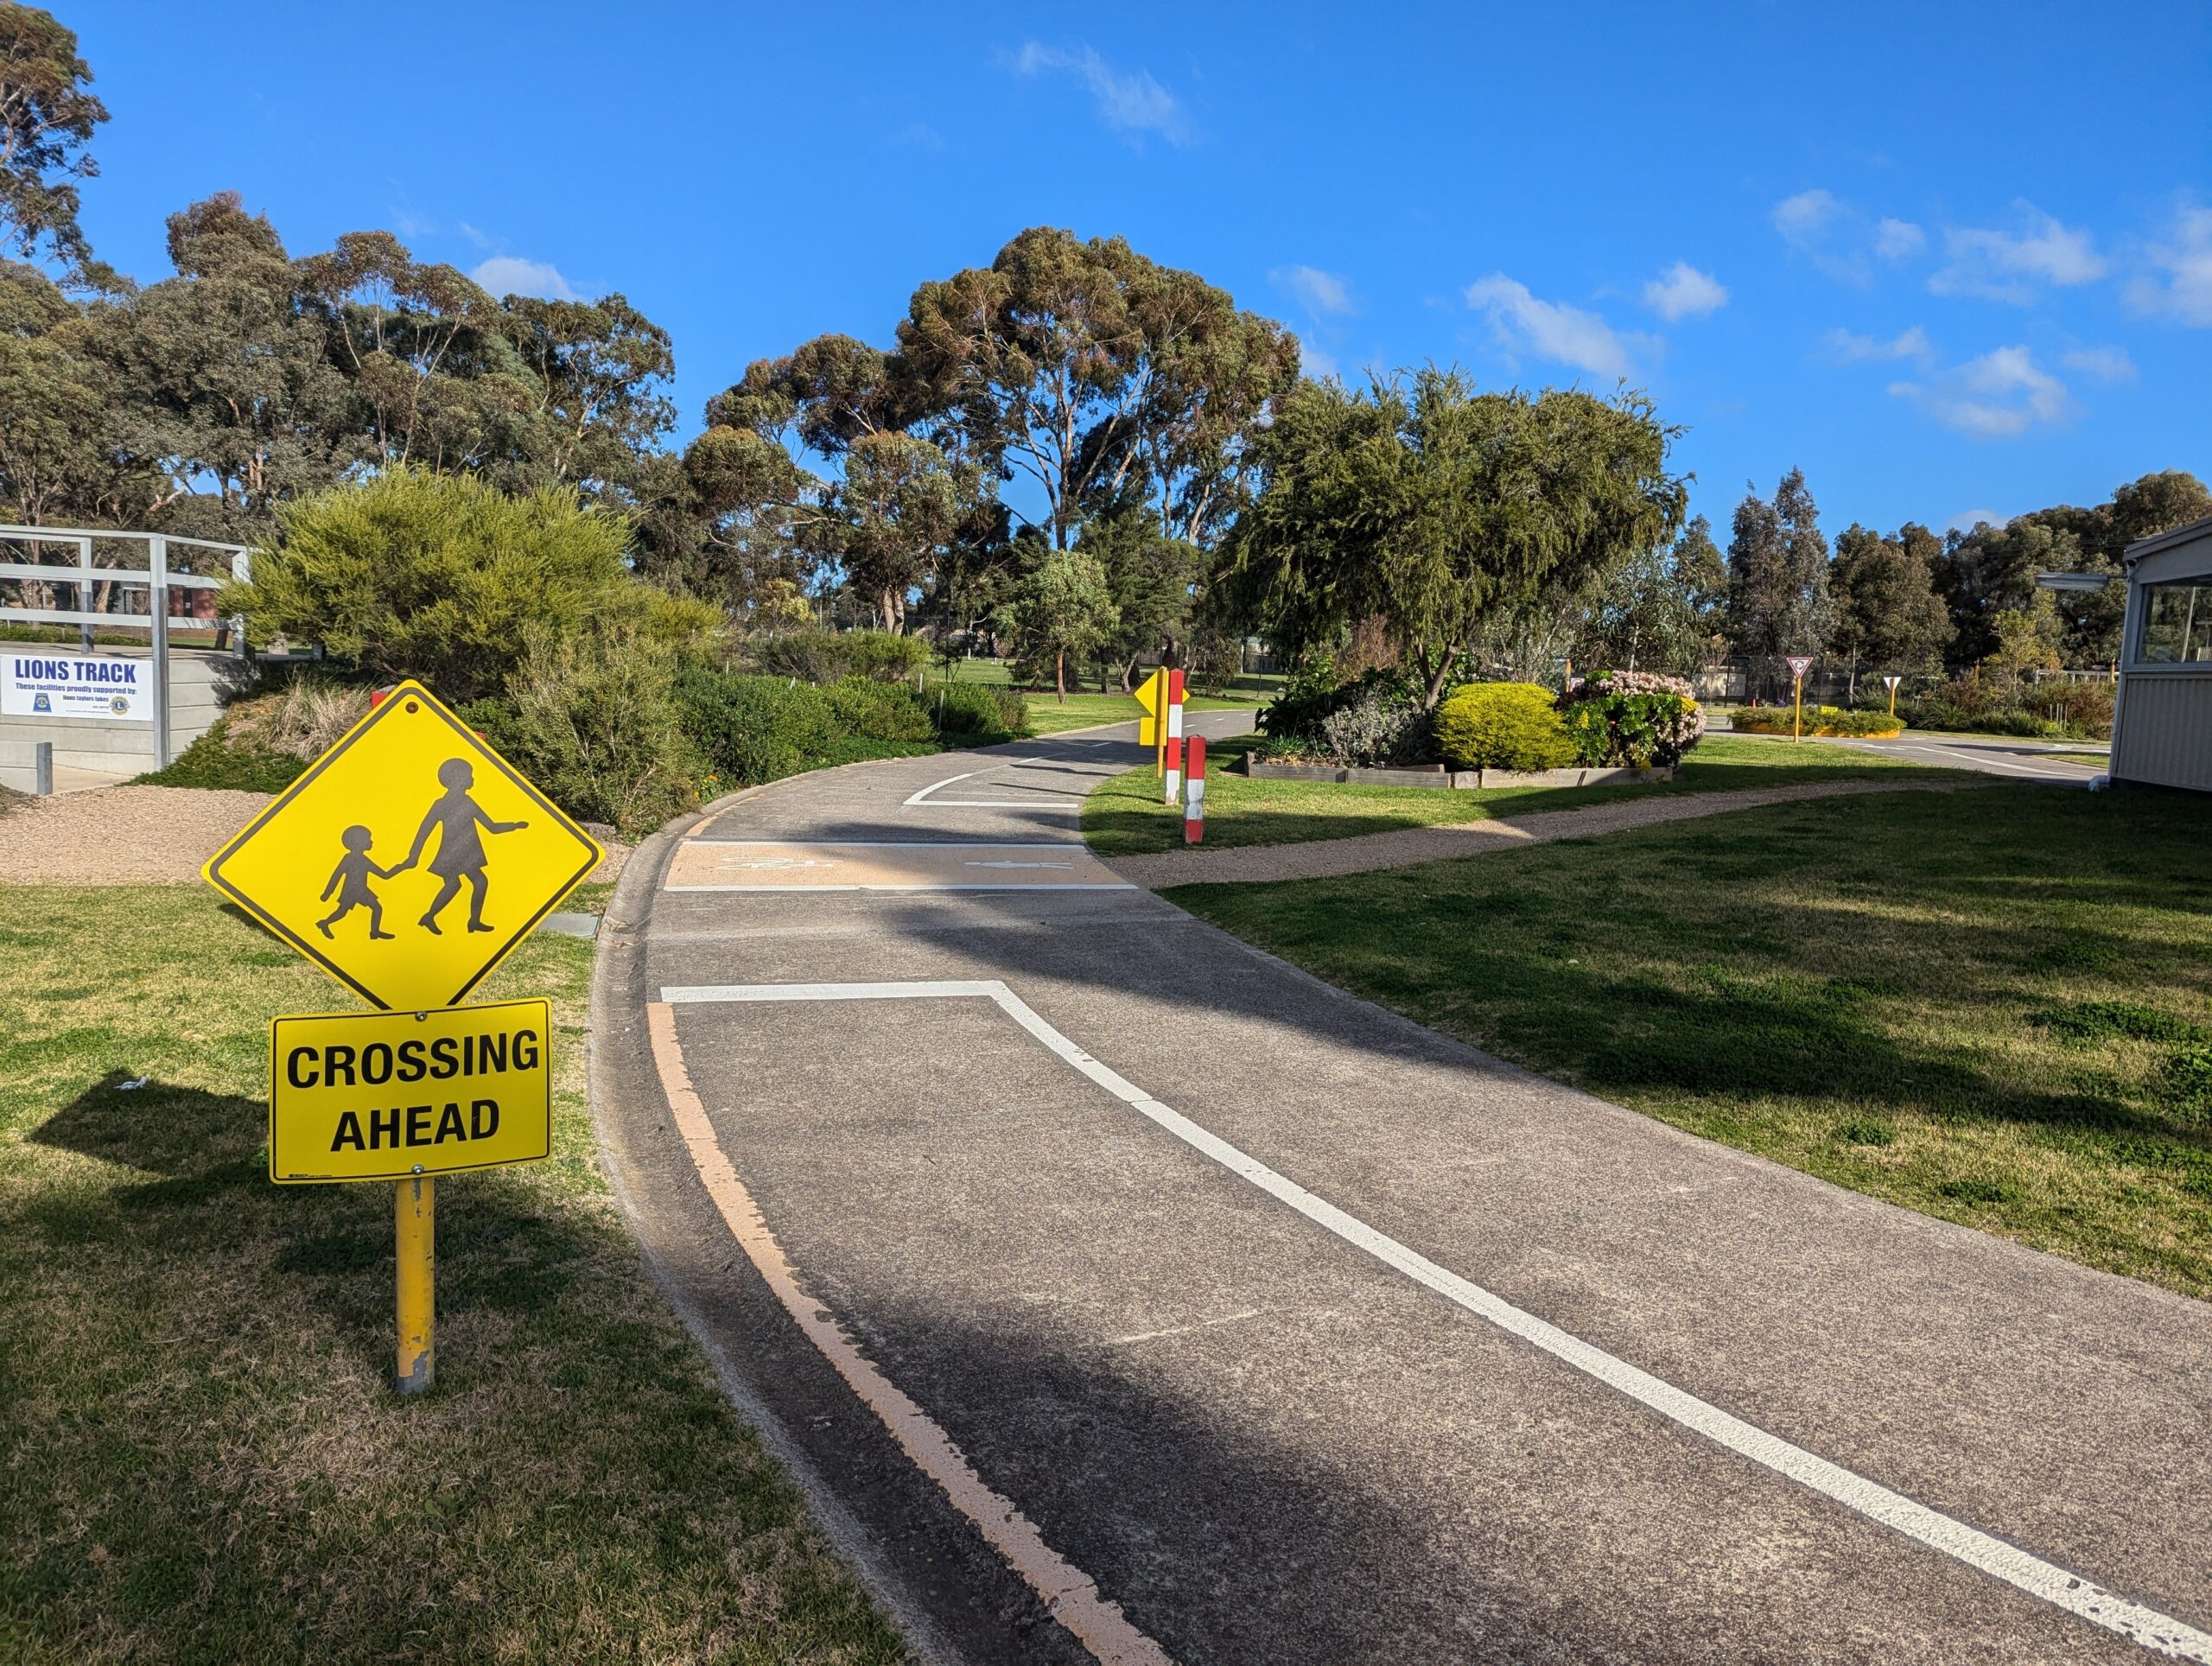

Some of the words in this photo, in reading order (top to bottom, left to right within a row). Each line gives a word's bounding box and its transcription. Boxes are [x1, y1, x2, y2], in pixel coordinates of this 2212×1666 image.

[16, 659, 69, 680] LIONS
[73, 662, 137, 683] TRACK
[287, 1029, 538, 1089] CROSSING
[330, 1099, 499, 1152] AHEAD
